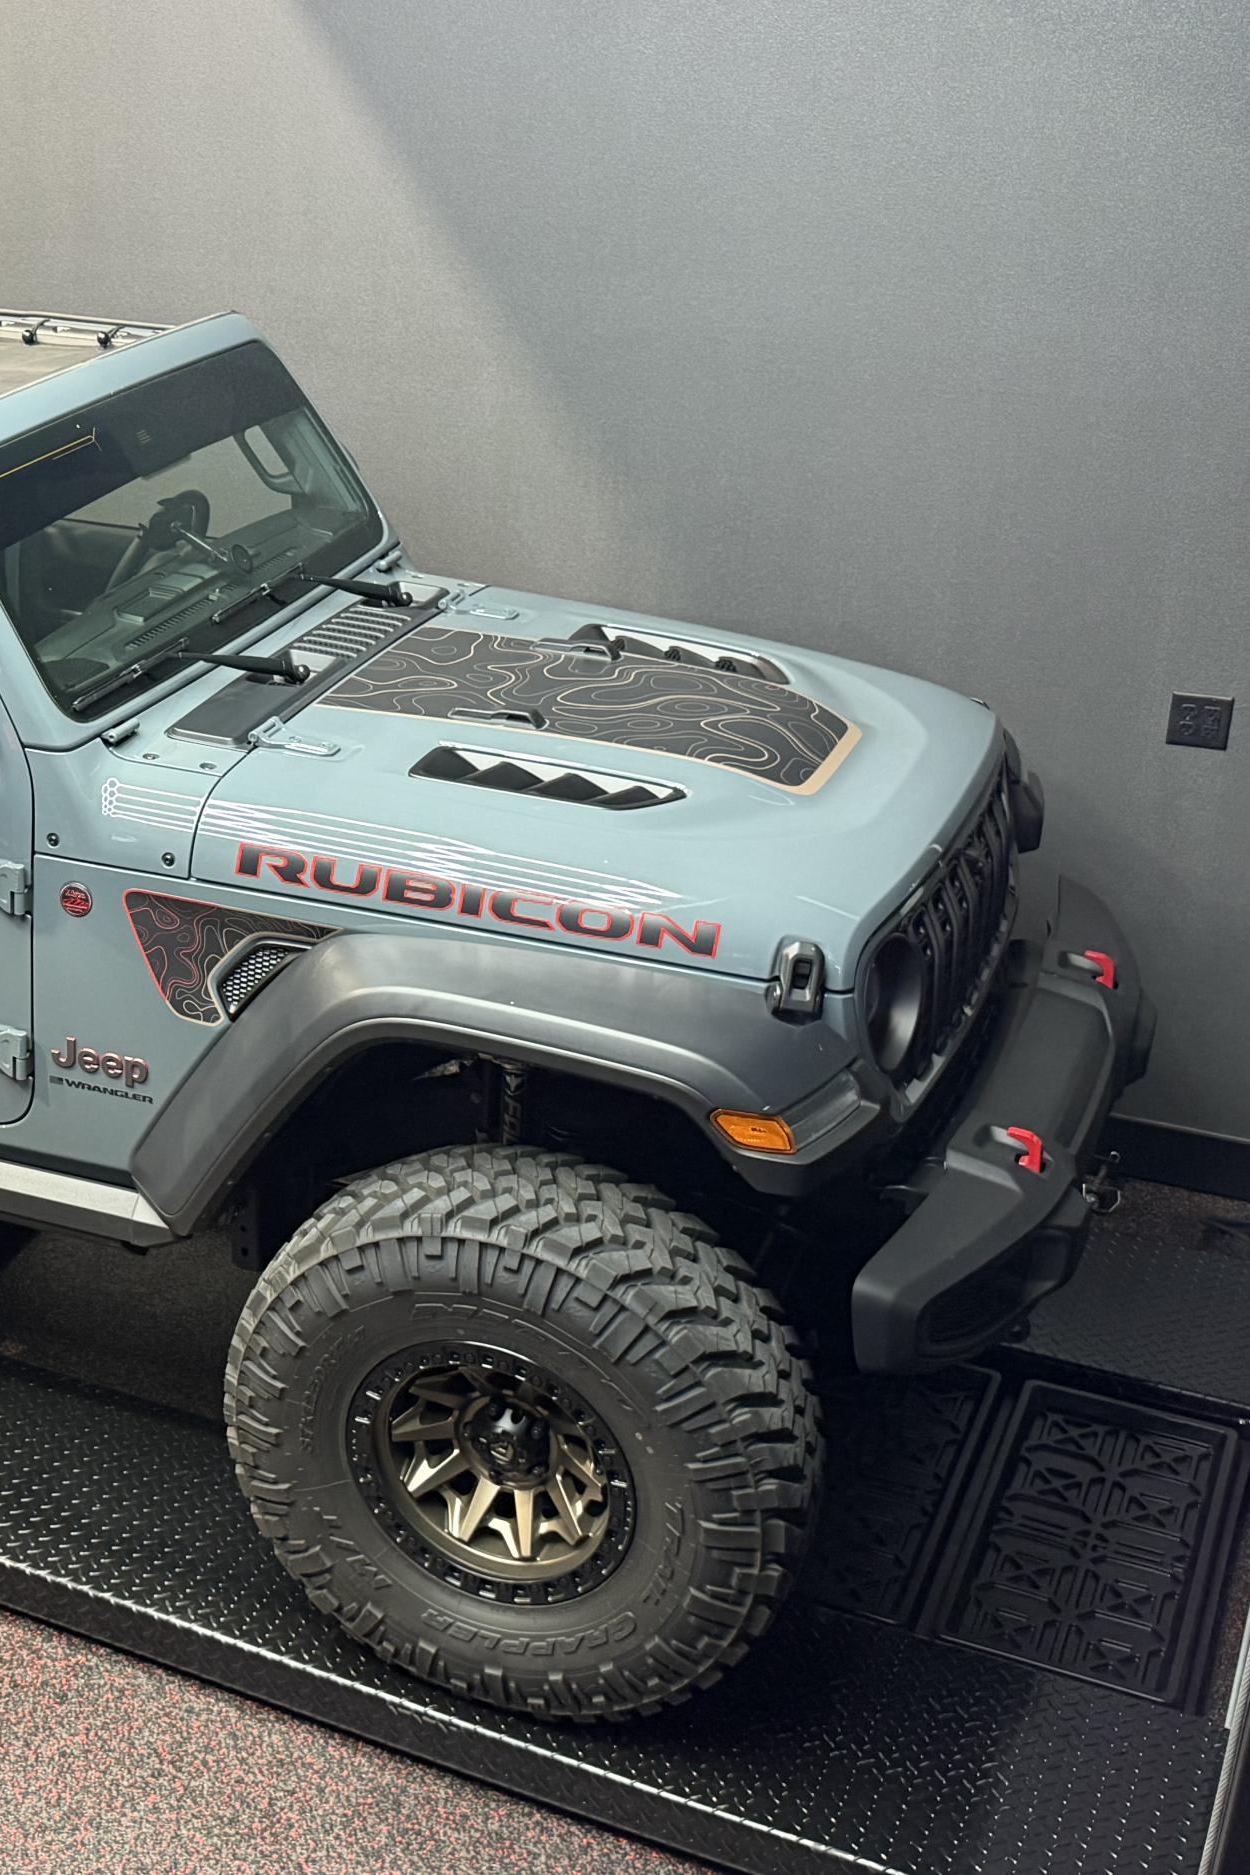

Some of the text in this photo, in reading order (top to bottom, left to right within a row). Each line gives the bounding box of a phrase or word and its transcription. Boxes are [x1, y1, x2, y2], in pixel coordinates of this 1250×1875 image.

[235, 842, 721, 958] RUBICON
[50, 1036, 149, 1088] Jeep
[65, 1078, 154, 1104] WRANGLER
[420, 1608, 636, 1656] GRAPPLER
